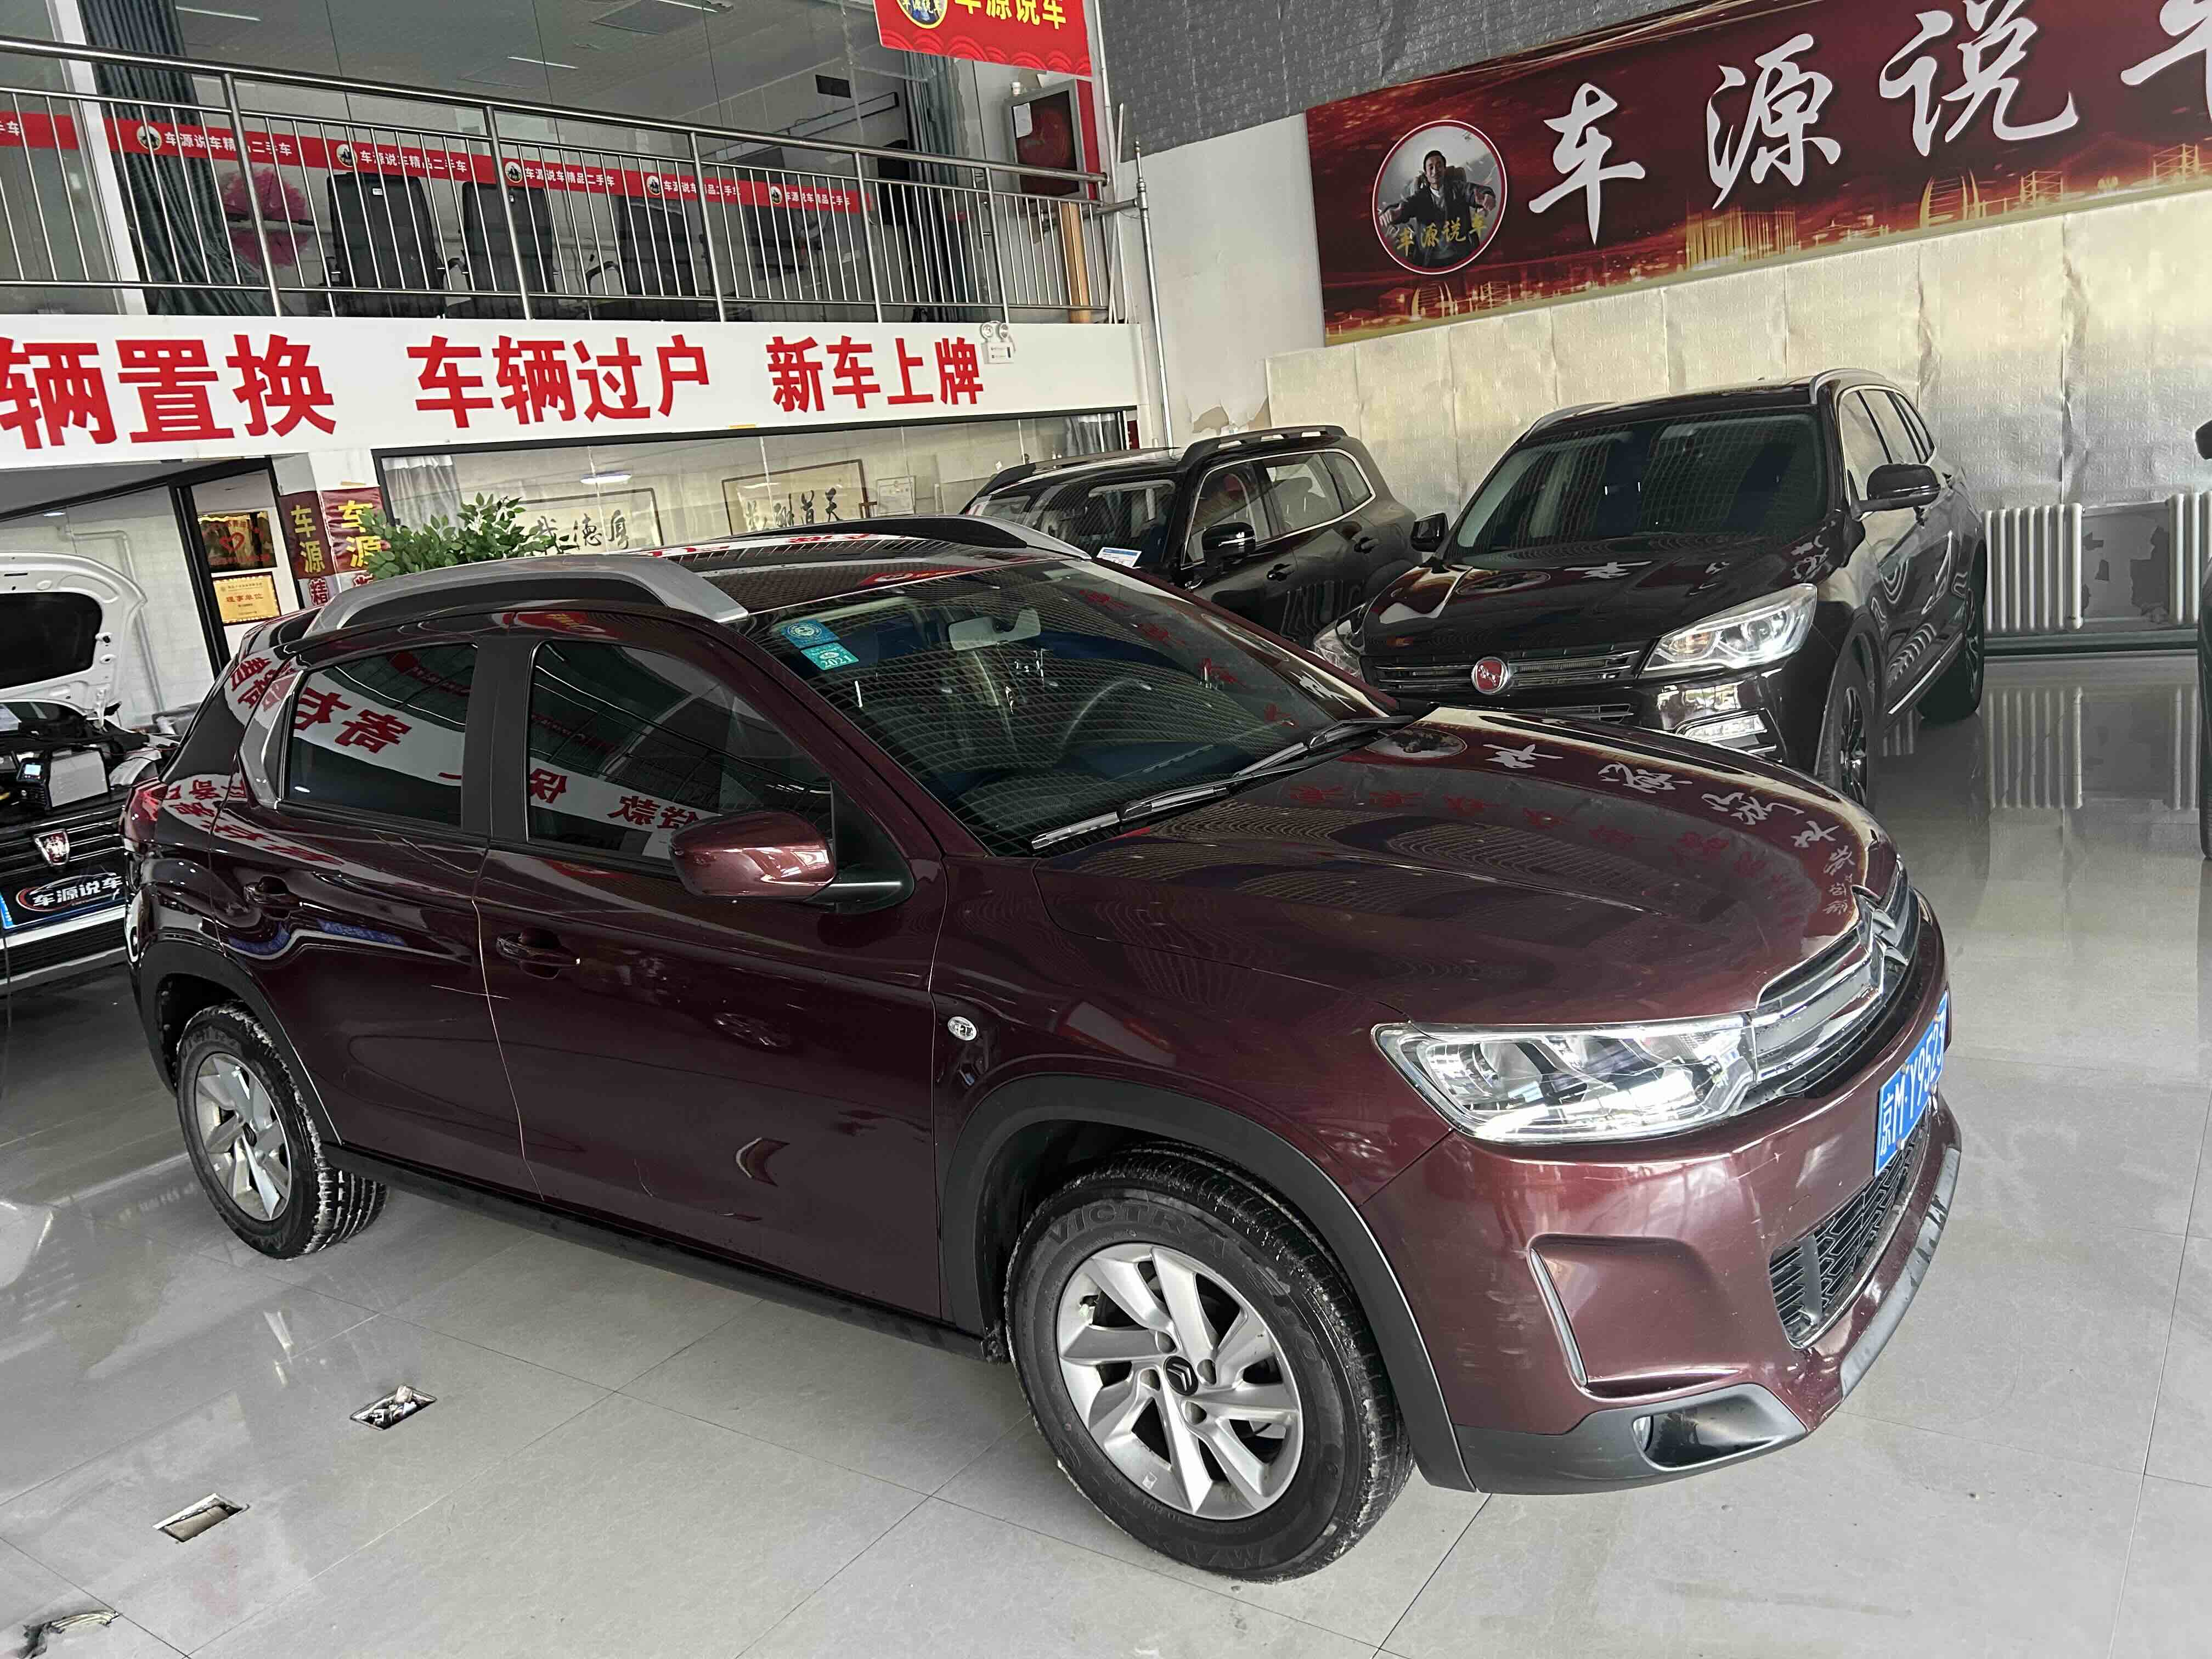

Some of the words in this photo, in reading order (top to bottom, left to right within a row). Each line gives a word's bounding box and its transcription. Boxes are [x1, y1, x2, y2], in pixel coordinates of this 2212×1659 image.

[165, 132, 292, 156] 车源说车精二手车
[0, 334, 337, 449] 辆置换
[407, 332, 709, 428] 车辆过户
[766, 335, 984, 413] 新车上牌
[290, 504, 326, 573] 车源
[821, 655, 852, 668] 2021
[33, 876, 123, 906] 车源说车
